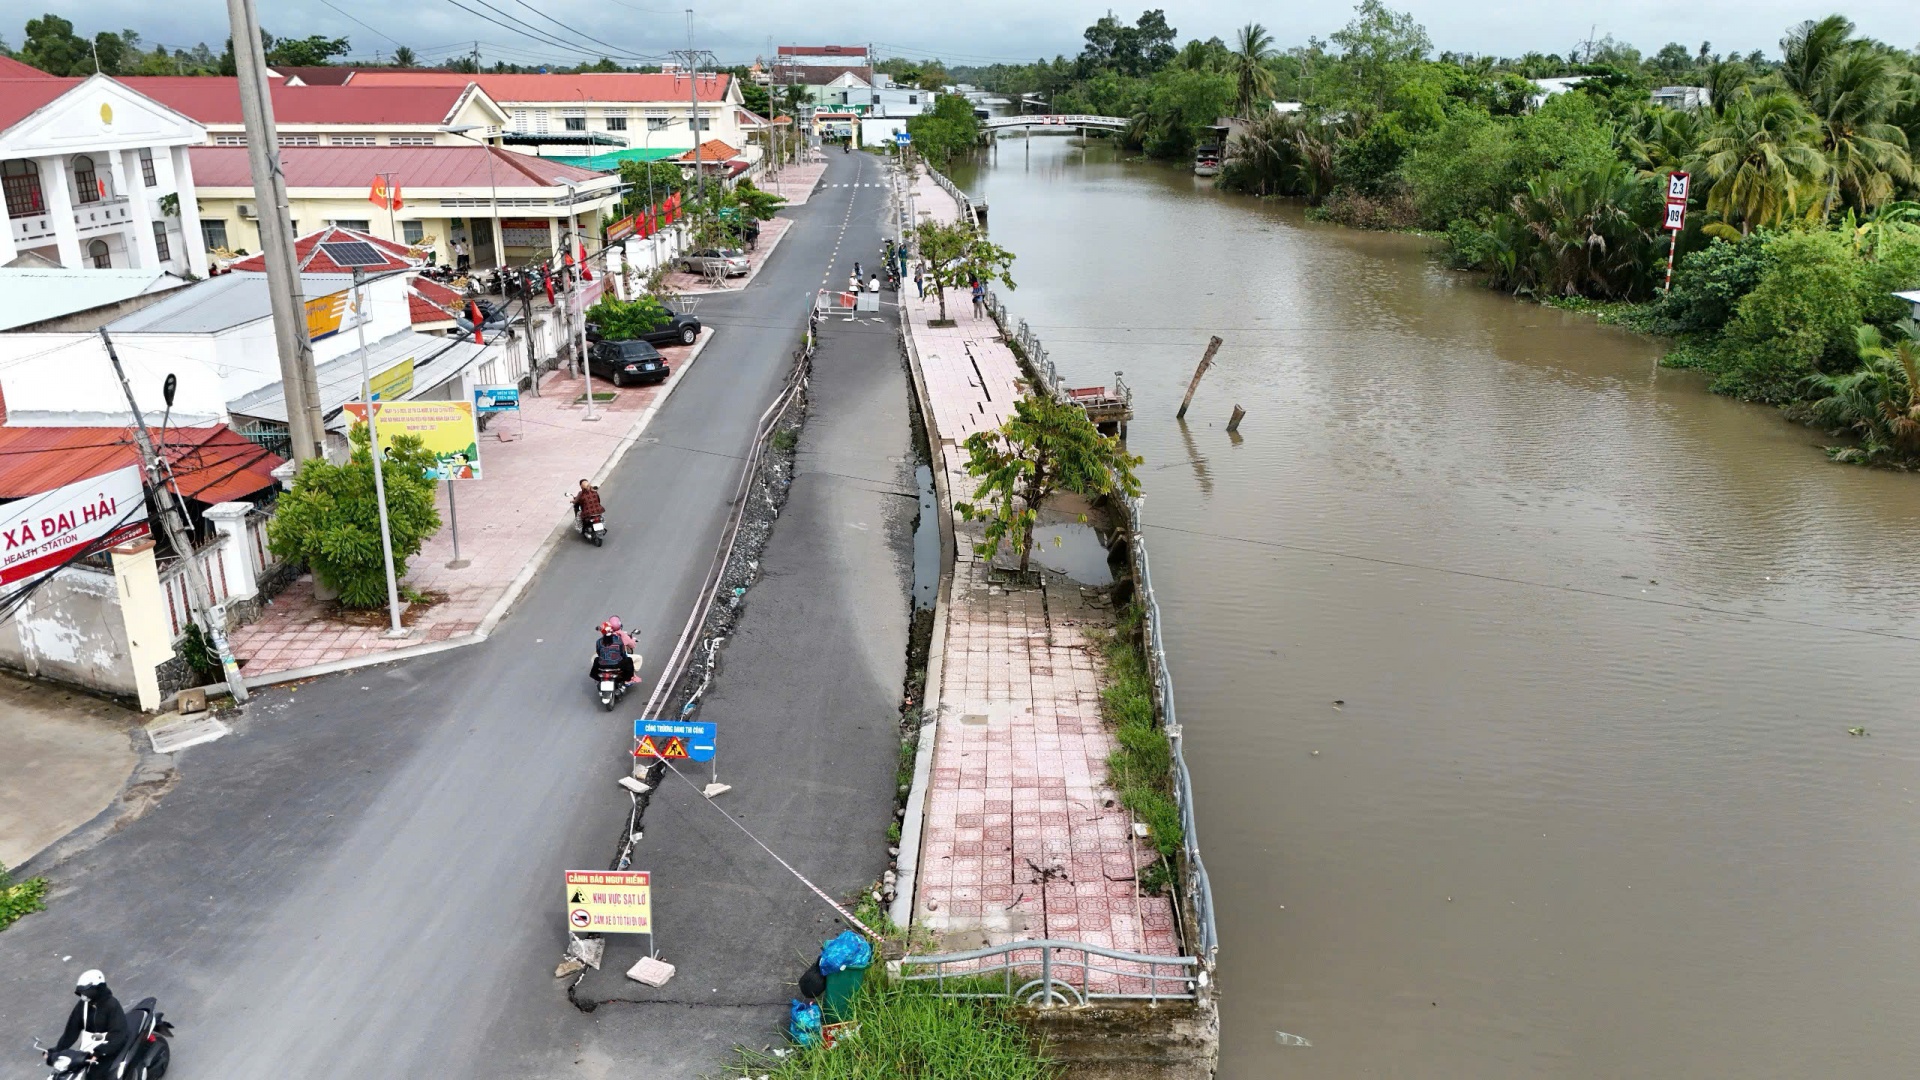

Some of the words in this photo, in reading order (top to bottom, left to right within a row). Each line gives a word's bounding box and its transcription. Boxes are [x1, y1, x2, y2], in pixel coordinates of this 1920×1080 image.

[1672, 182, 1684, 194] 2.3
[1670, 210, 1680, 222] 09
[3, 518, 36, 551] XÃ
[82, 493, 117, 524] HẢI
[4, 547, 38, 566] HEALTH
[42, 534, 78, 552] STATION
[569, 873, 588, 883] CẢNH
[590, 874, 604, 883] BÁO
[593, 893, 606, 904] KHU
[608, 893, 621, 907] VỰC
[624, 894, 636, 907] SẠT
[638, 891, 646, 905] LỞ
[606, 916, 611, 925] XE
